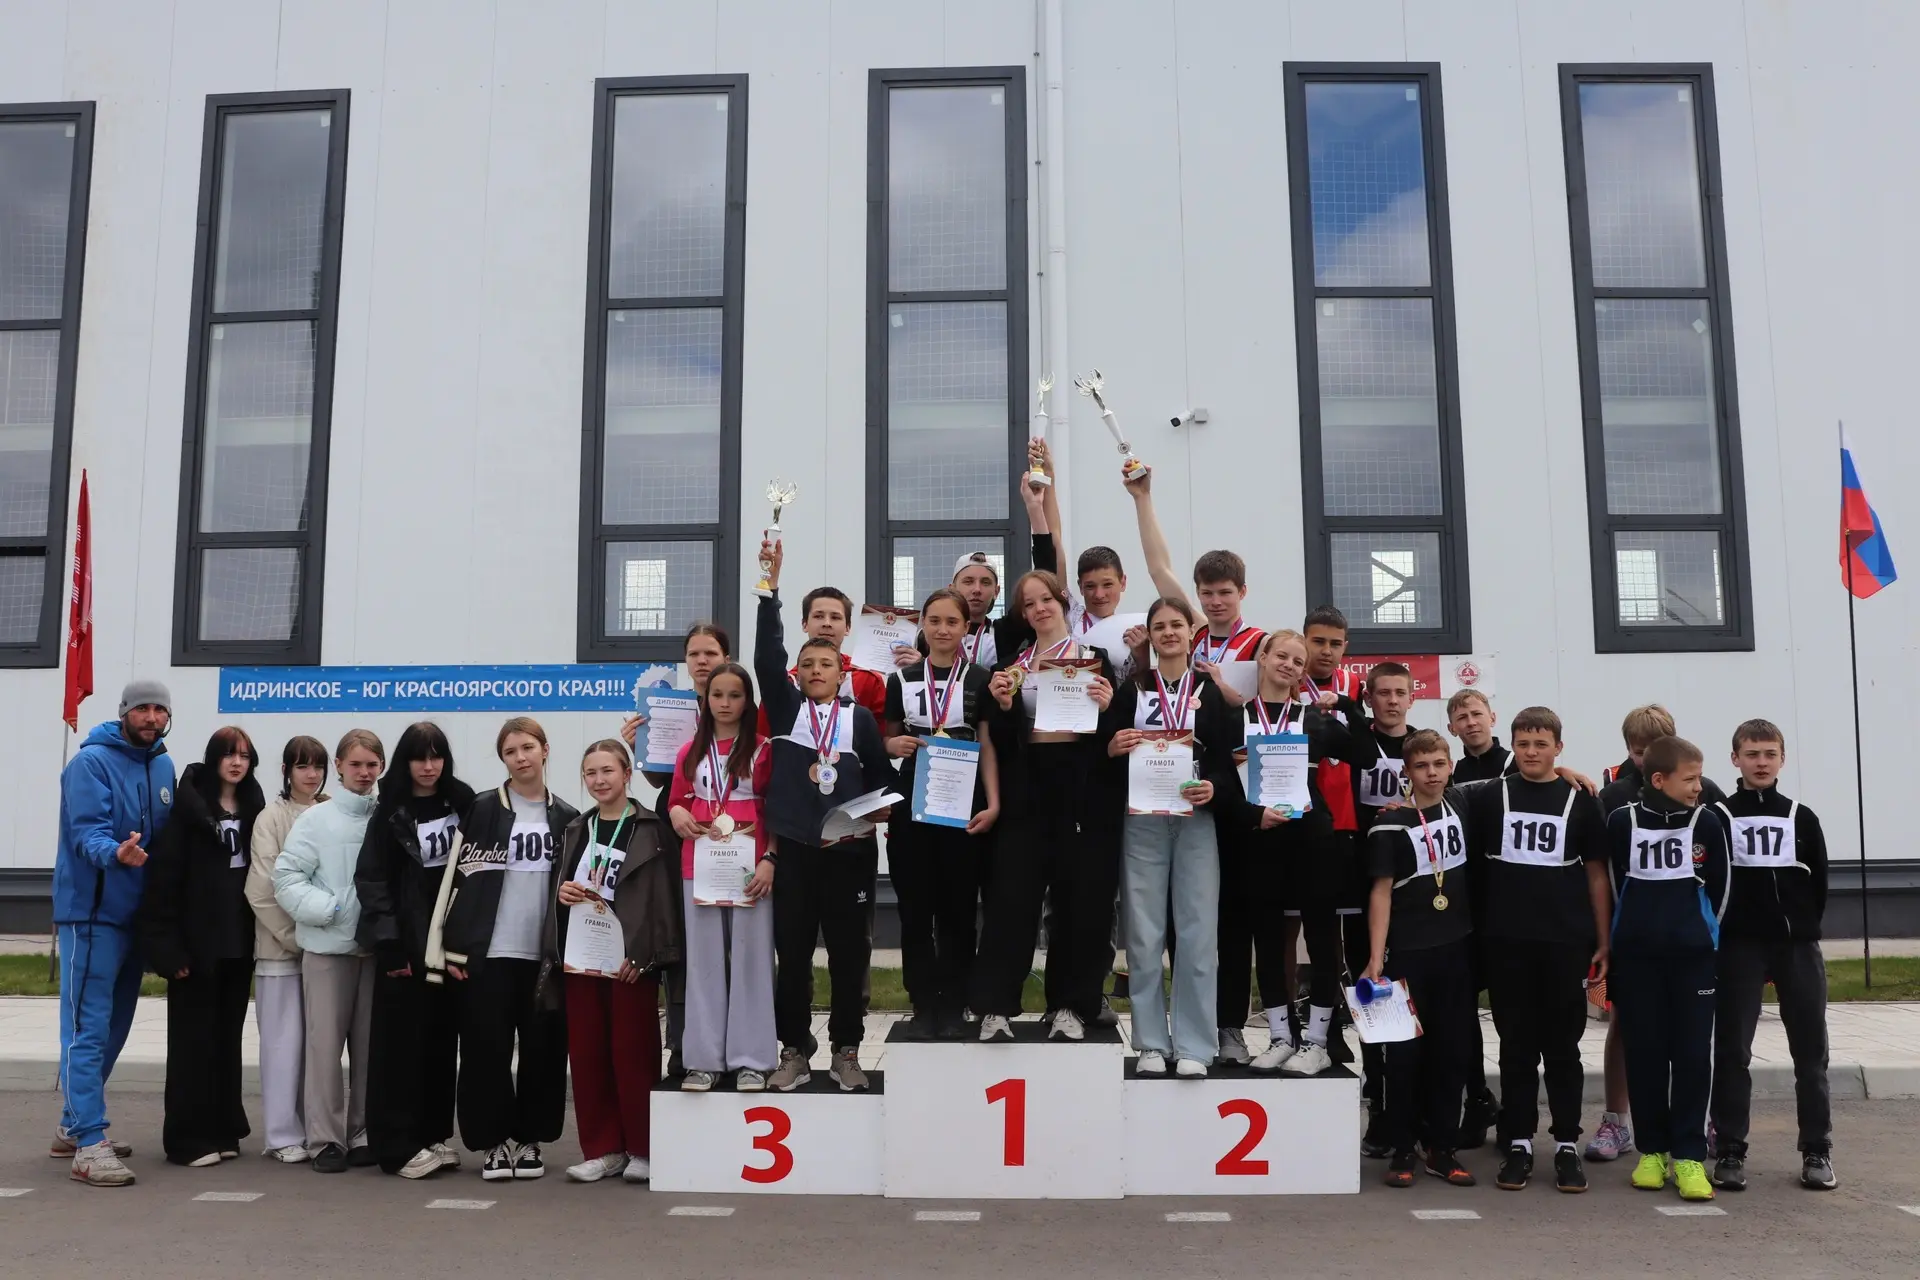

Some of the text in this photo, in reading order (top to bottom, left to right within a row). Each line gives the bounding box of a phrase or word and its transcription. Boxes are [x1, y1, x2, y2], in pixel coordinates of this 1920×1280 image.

[873, 629, 899, 637] ГРАМОТА
[230, 681, 341, 701] ИДРИНСКОЕ
[363, 681, 391, 698] ЮГ
[394, 680, 552, 698] КРАСНОЯРСКОГО
[558, 679, 625, 697] КРАЯ!!!
[1053, 685, 1082, 693] ГРАМОТА
[936, 748, 968, 758] ДИПЛОМ
[512, 832, 554, 862] 109
[1420, 825, 1462, 862] 118
[1511, 819, 1557, 853] 119
[1742, 826, 1784, 856] 117
[1637, 838, 1684, 869] 116
[585, 918, 612, 930] ГРАМОТА
[1361, 1004, 1374, 1028] ГРАМОТ
[986, 1078, 1025, 1166] 1
[1215, 1098, 1270, 1176] 2
[740, 1106, 794, 1183] 3
